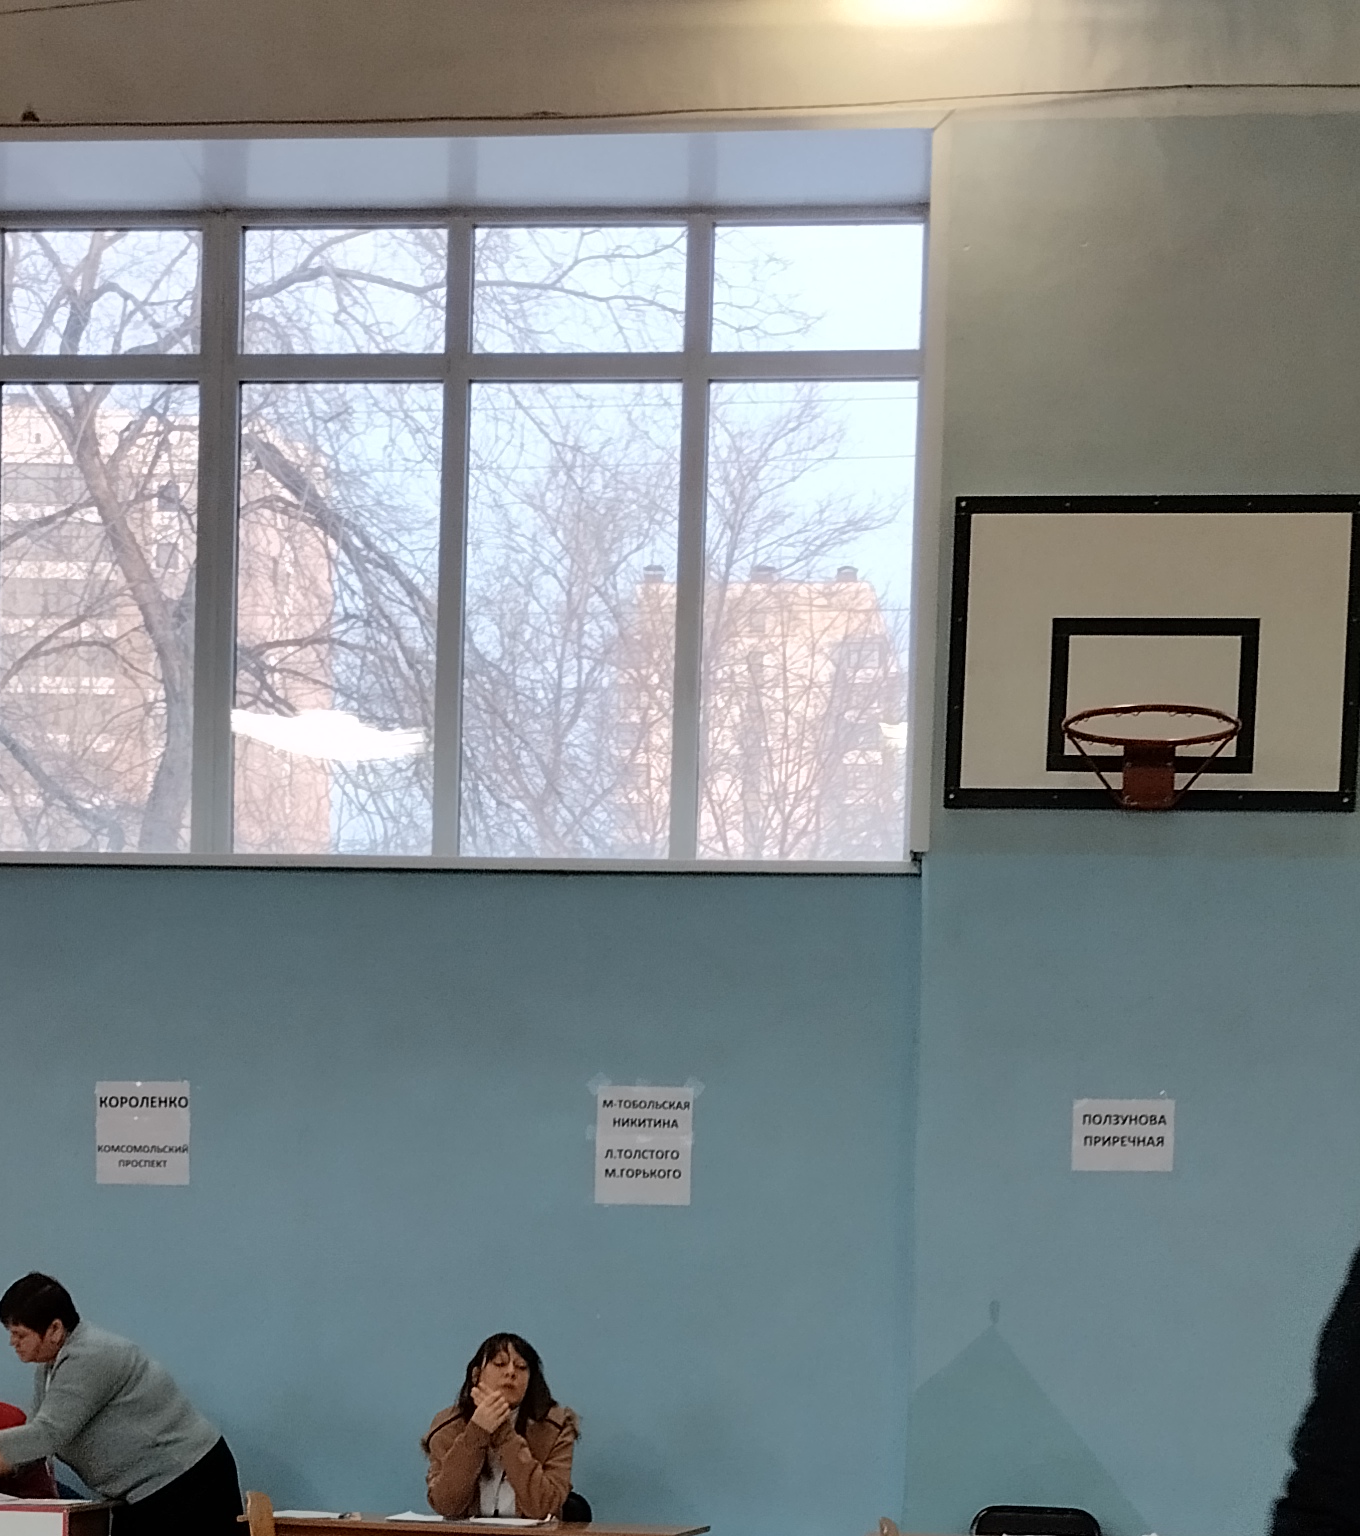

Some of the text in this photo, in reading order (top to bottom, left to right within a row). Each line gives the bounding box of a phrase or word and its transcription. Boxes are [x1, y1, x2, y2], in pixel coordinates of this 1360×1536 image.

[99, 1095, 189, 1108] КОРОЛЕНКО
[602, 1099, 691, 1110] М-ТОБОЛЬСКАЯ
[612, 1117, 679, 1129] НИКИТИНА
[1082, 1113, 1167, 1126] ПОЛЗУНОВА
[1083, 1135, 1165, 1147] ПРИРЕЧНАЯ
[97, 1143, 189, 1154] КОМСОМОЛЬСКИЙ
[118, 1159, 167, 1168] ПРОСПЕКТ
